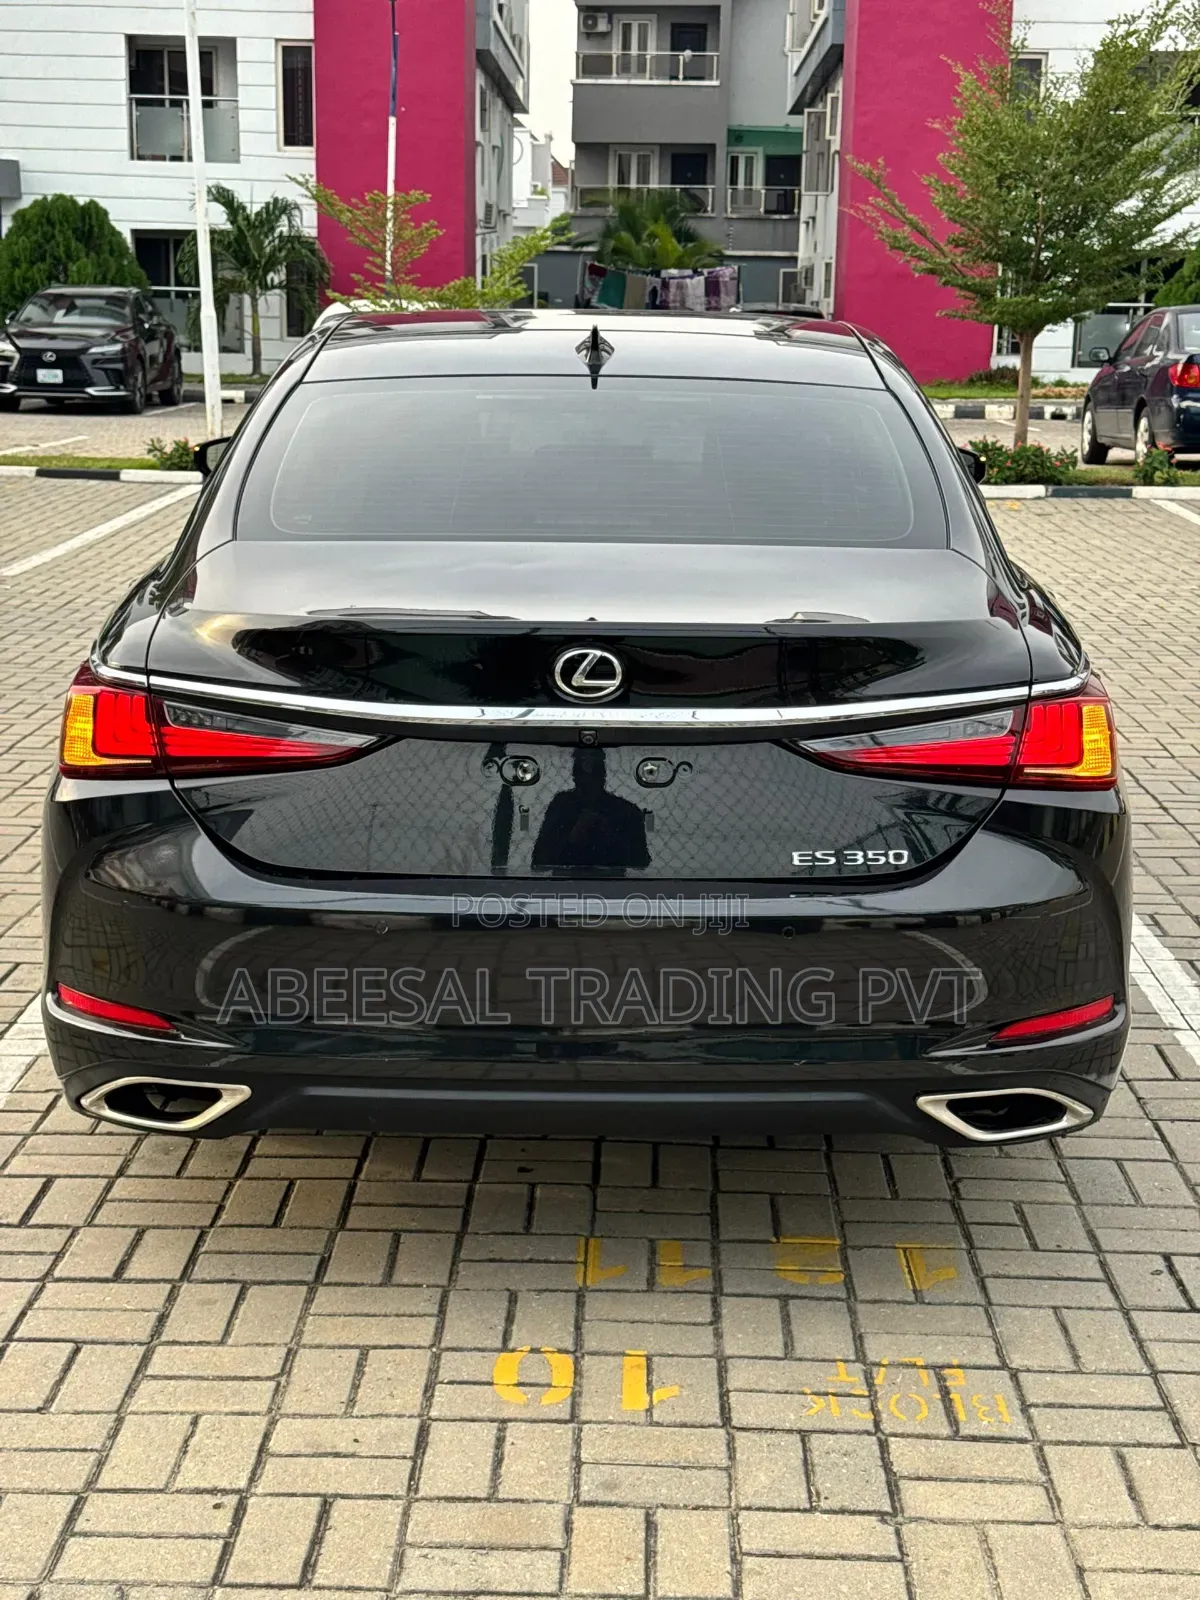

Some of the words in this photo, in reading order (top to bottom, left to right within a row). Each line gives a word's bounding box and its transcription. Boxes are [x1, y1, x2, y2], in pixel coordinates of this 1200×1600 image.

[791, 850, 837, 866] ES
[843, 849, 909, 866] 350
[801, 1388, 1011, 1424] BLOCK
